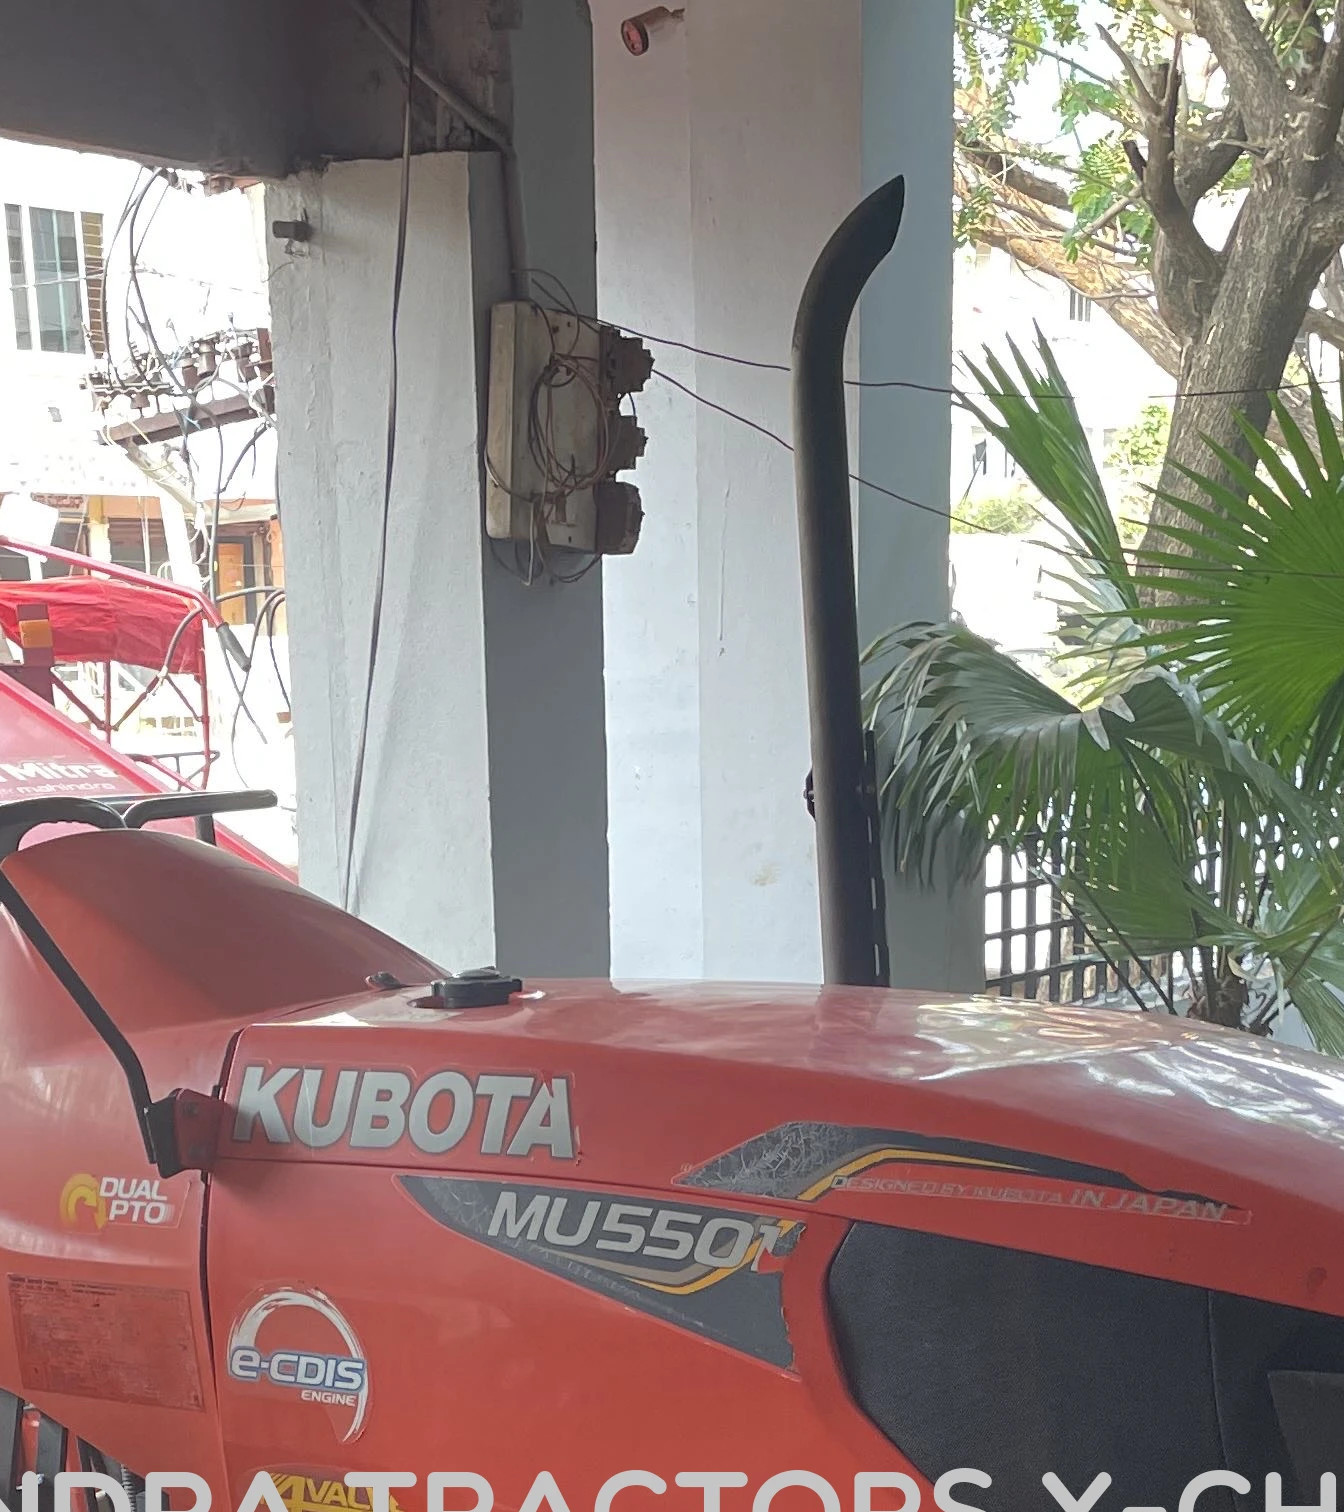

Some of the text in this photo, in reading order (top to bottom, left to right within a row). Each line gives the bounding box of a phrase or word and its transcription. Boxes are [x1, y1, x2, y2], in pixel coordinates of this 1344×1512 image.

[232, 1065, 575, 1159] KUBOTA
[99, 1176, 168, 1201] DUAL
[830, 1175, 1228, 1221] DESIGNED BY KUBOTA IN JAPAN
[108, 1199, 167, 1224] PTO
[230, 1348, 364, 1391] e-CDIS
[300, 1388, 357, 1407] ENGINE
